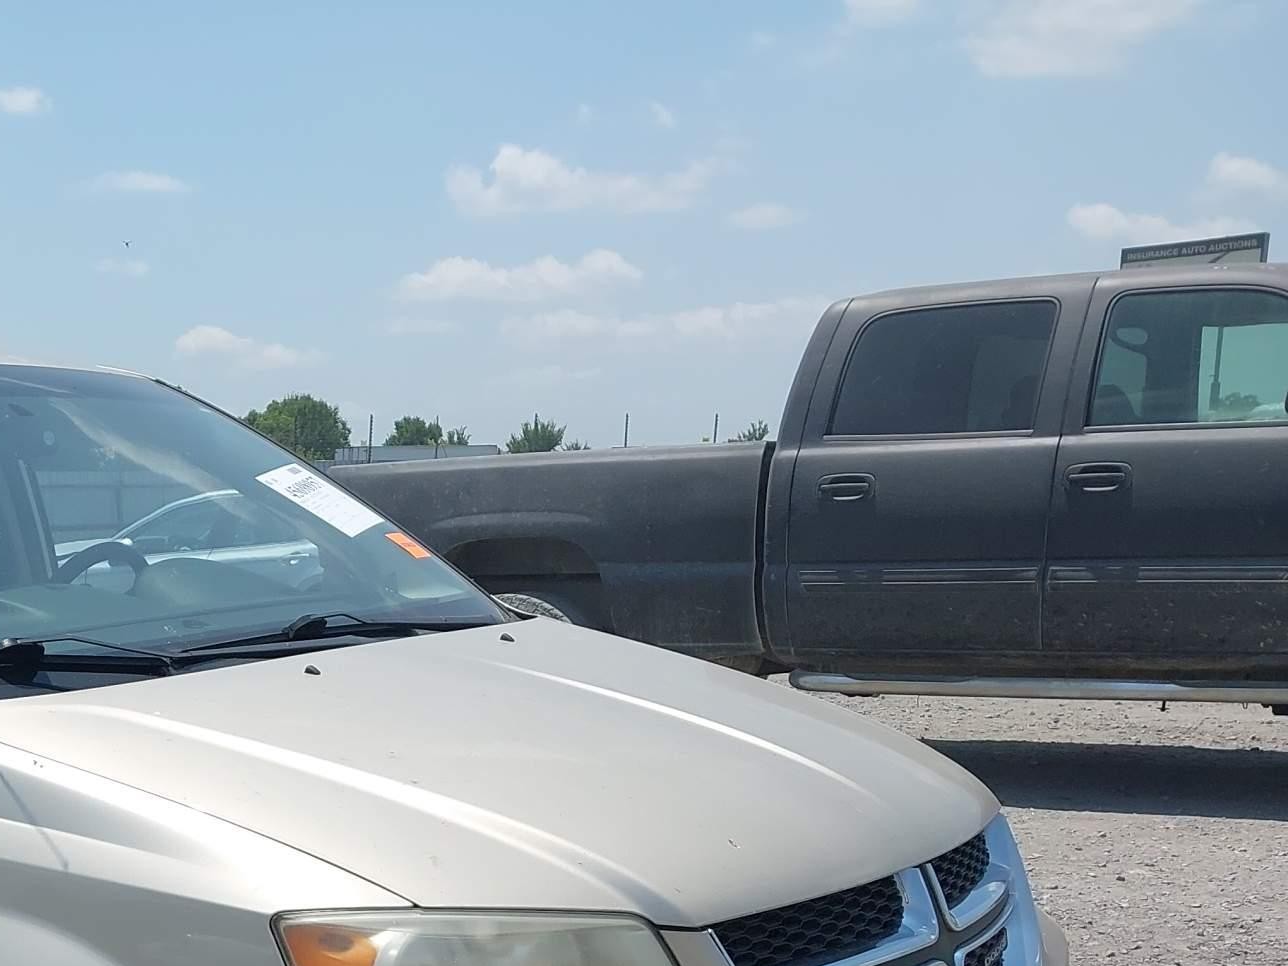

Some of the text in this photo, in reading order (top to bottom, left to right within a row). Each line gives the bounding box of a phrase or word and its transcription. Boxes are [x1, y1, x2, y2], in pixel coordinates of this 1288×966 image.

[1127, 239, 1258, 260] INSURANCE AUTO AUCTIONS
